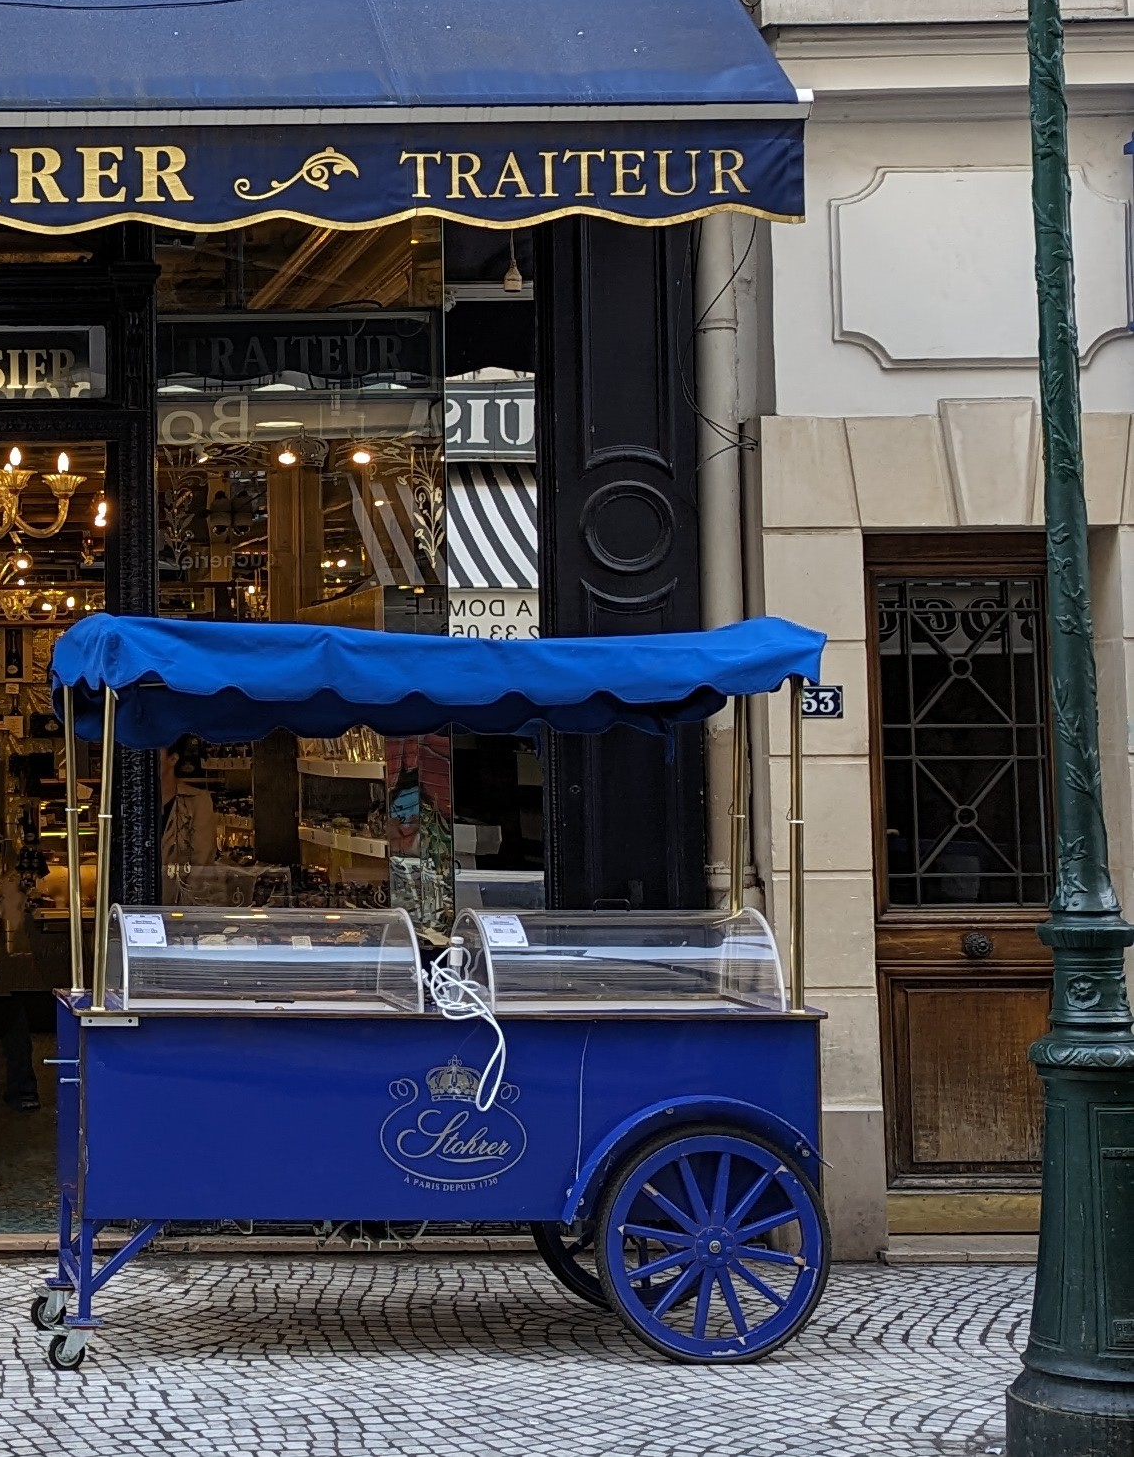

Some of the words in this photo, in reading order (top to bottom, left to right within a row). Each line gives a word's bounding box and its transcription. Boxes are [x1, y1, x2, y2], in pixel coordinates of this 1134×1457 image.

[399, 148, 751, 198] TRAITEUR
[178, 335, 404, 375] TRAITEUR
[802, 691, 835, 713] 53
[396, 1109, 512, 1159] Stohrer
[413, 1179, 441, 1191] PARIS
[442, 1181, 477, 1192] DEPUIS
[479, 1177, 499, 1189] 1730
